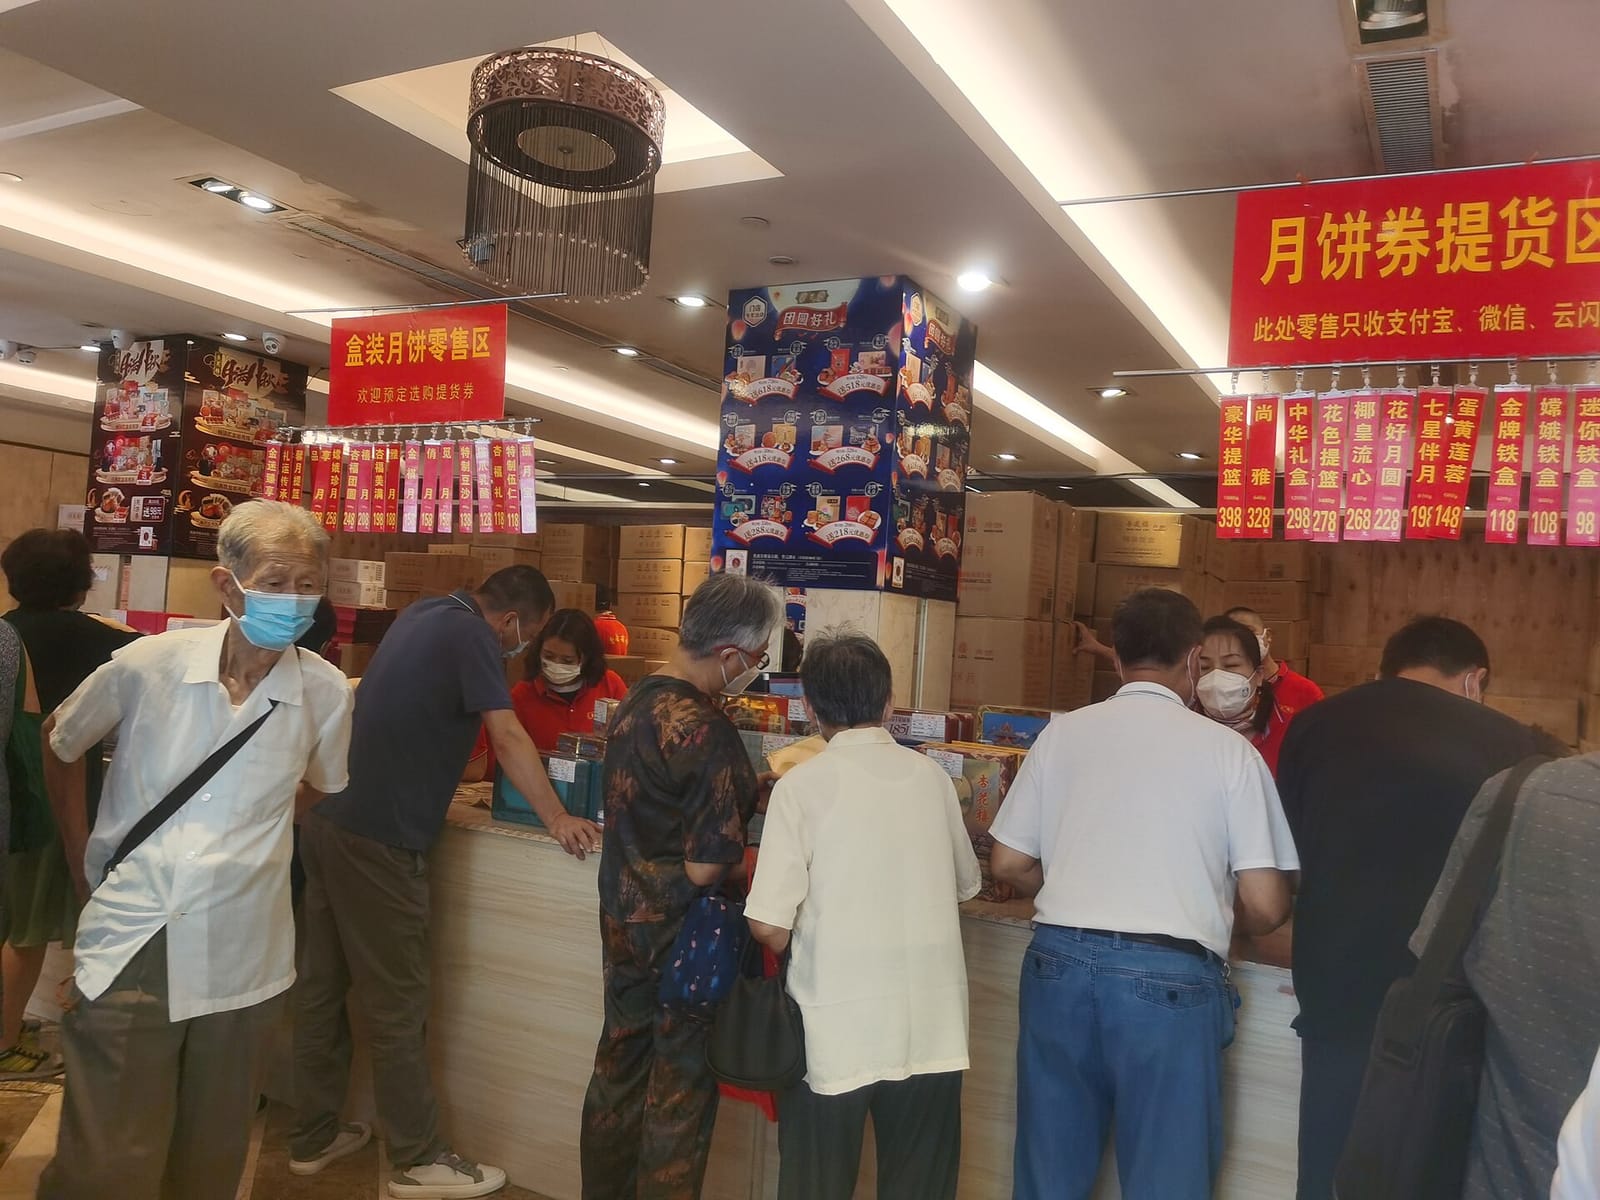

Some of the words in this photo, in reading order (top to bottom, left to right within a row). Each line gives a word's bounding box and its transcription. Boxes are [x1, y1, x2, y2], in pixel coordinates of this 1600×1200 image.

[1261, 196, 1600, 286] 月饼券提货区
[345, 326, 491, 367] 盒装月饼零售区
[357, 383, 474, 404] 欢迎预定选购提货券
[1222, 405, 1243, 486] 豪华提篮
[1251, 404, 1273, 486] 尚雅
[1288, 403, 1309, 486] 中华礼盒
[1317, 404, 1343, 488] 花色提篮
[1351, 401, 1376, 486] 椰皇流心
[1380, 400, 1409, 487] 花好月圆
[1416, 398, 1445, 484] 七星伴月
[1444, 398, 1479, 484] 蛋黄莲蓉
[1494, 397, 1523, 486] 金牌铁盒
[1535, 397, 1563, 487] 嫦娥铁盒
[1574, 397, 1600, 487] 迷你铁盒
[460, 446, 471, 499] 特制豆沙
[506, 445, 518, 499] 特制伍仁
[507, 512, 519, 527] 118
[1218, 507, 1242, 528] 398
[1247, 507, 1271, 528] 328
[1287, 507, 1310, 529] 298
[1312, 511, 1337, 532] 278
[1346, 508, 1371, 530] 268
[1374, 508, 1400, 530] 228
[1435, 504, 1461, 528] 148
[1490, 509, 1516, 532] 118
[1532, 511, 1558, 534] 108
[1576, 511, 1595, 534] 98
[889, 724, 910, 736] 1851
